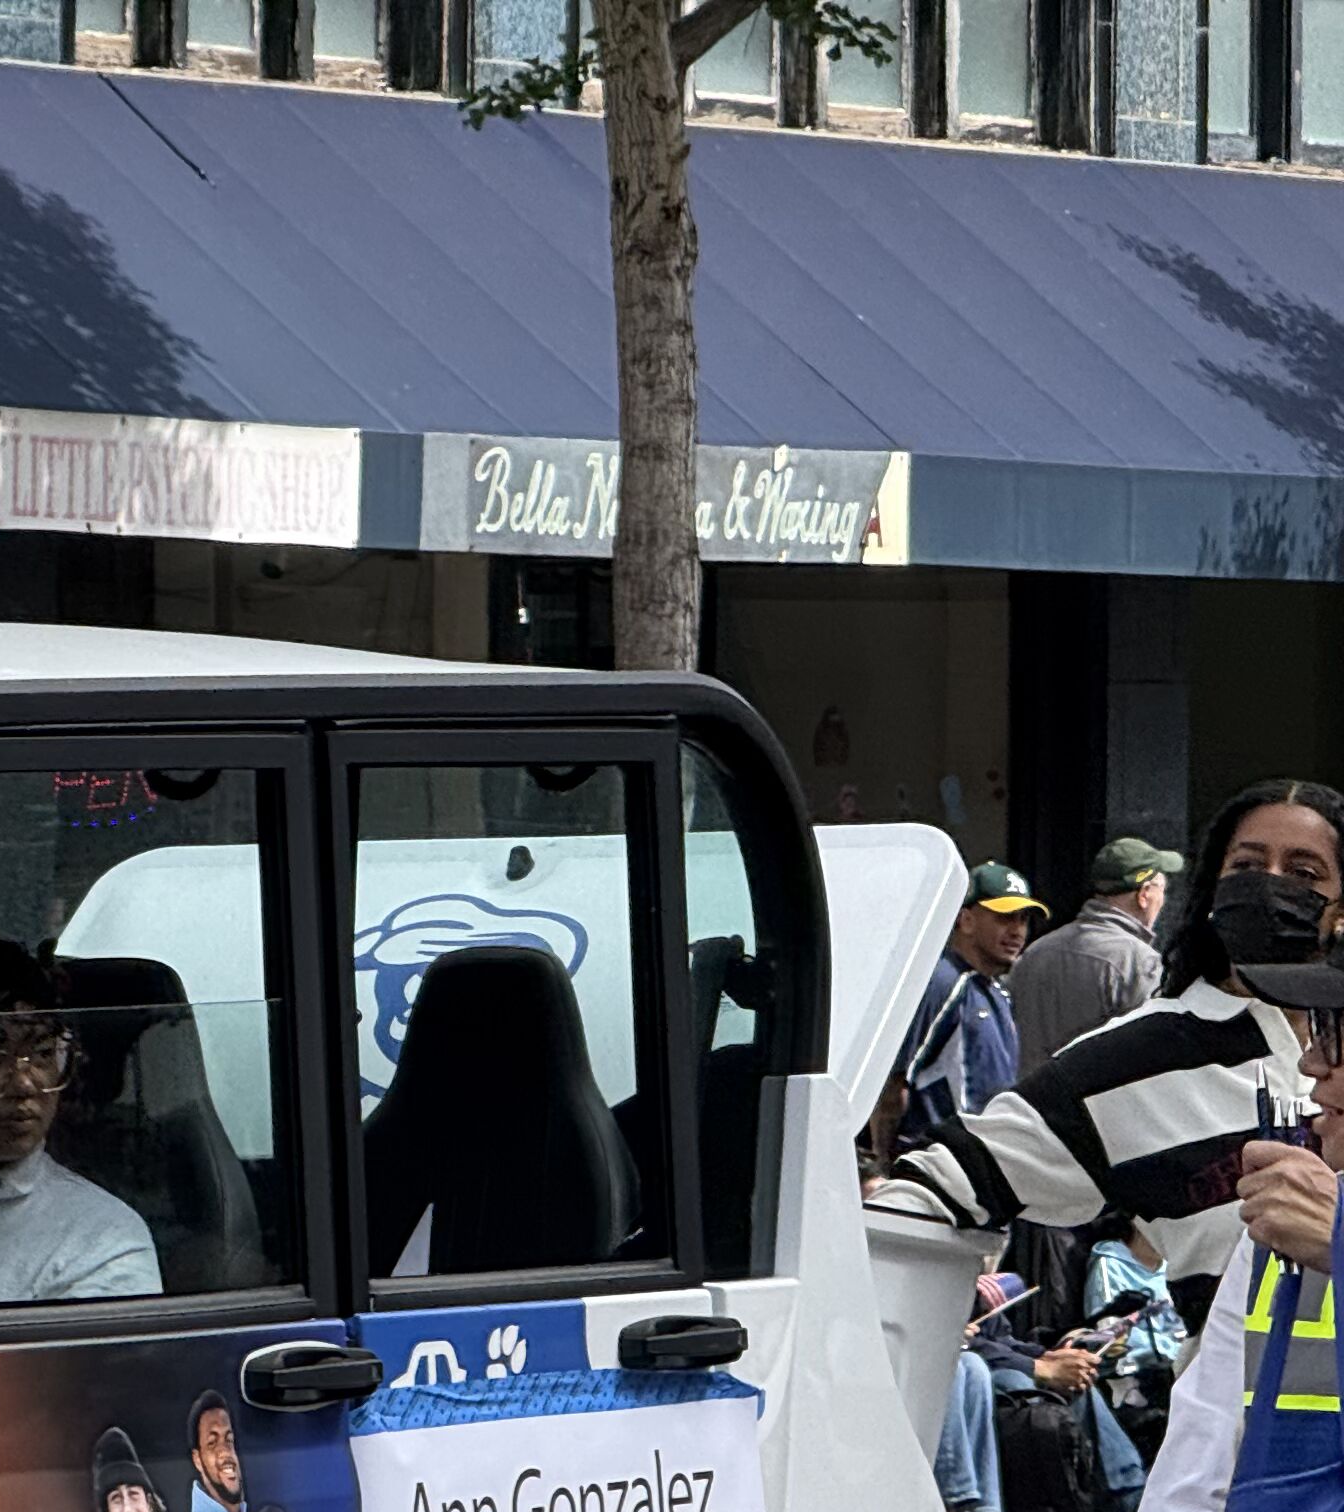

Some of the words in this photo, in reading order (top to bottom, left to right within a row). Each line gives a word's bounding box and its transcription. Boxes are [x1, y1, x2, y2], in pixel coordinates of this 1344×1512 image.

[12, 433, 121, 523] LITTLE
[126, 441, 258, 534] PSYCHIC
[474, 446, 571, 535] Bella
[722, 459, 752, 541] &
[754, 465, 861, 562] Waxing
